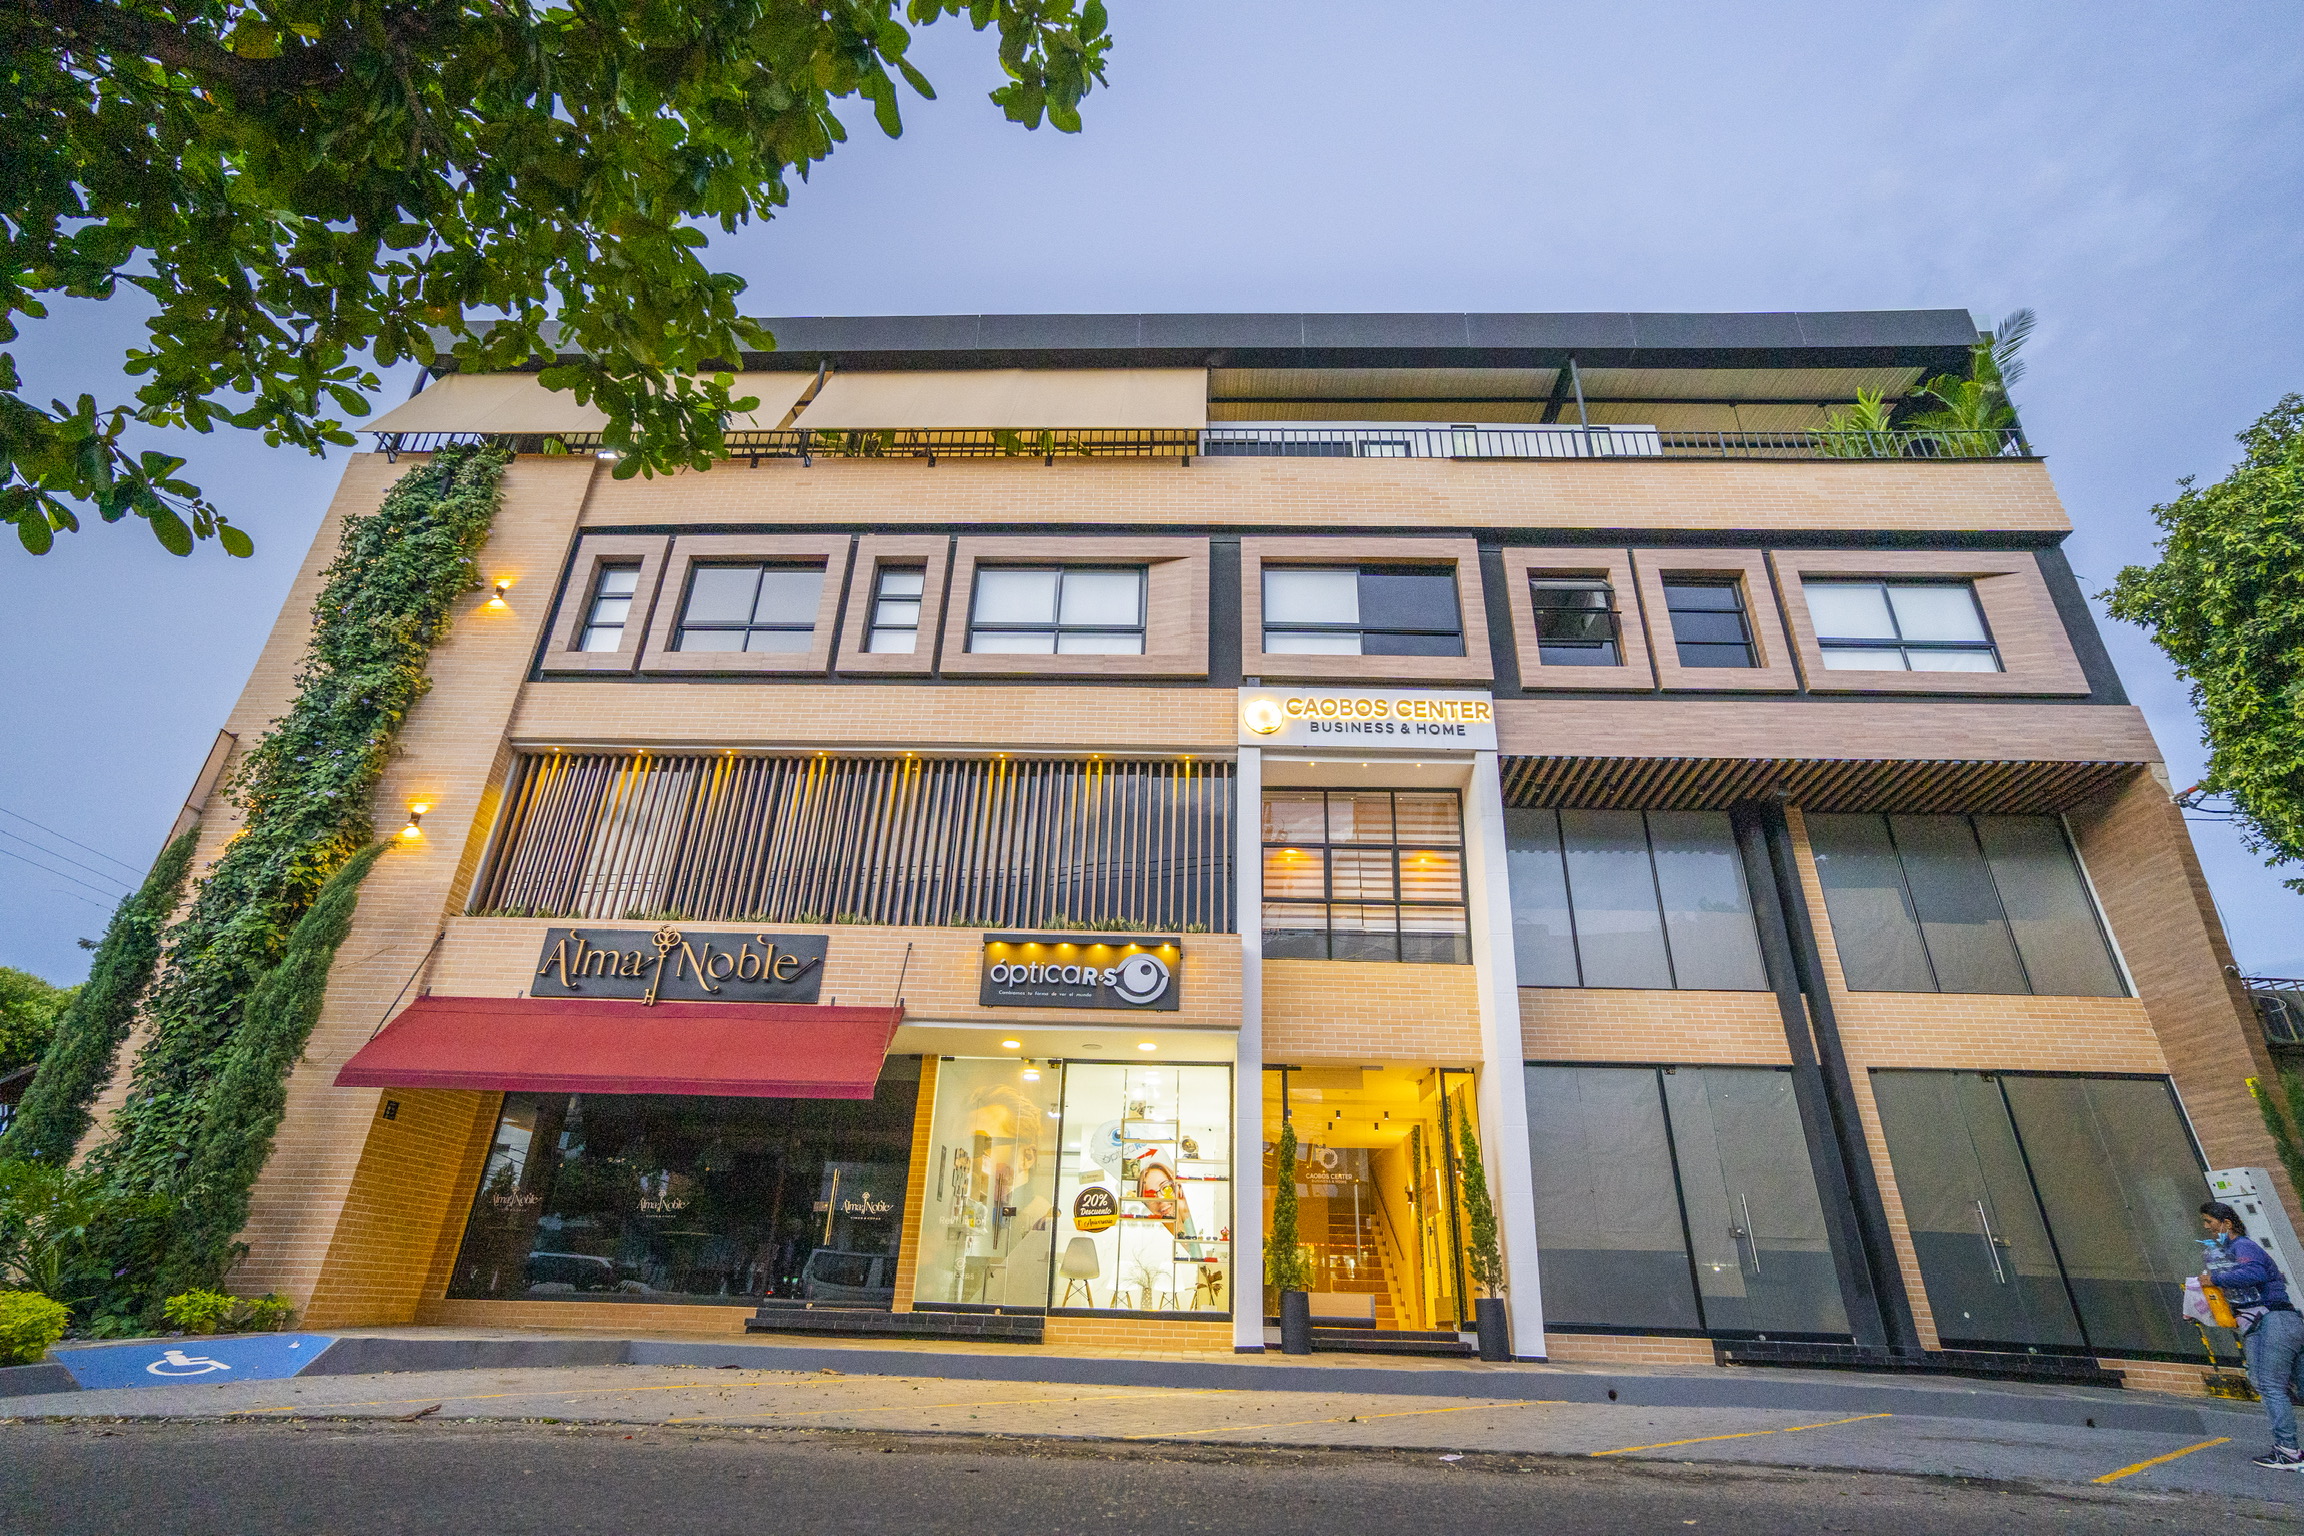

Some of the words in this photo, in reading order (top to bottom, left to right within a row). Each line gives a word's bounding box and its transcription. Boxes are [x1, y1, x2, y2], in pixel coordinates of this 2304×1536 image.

[1286, 698, 1389, 717] CAOBOS
[1395, 700, 1490, 720] CENTER
[1310, 721, 1395, 735] BUSINESS
[1400, 723, 1411, 734] &
[1416, 723, 1466, 736] HOME
[537, 928, 656, 990] Alma
[676, 933, 819, 994] Noble
[1082, 1194, 1108, 1207] 20%
[1080, 1207, 1112, 1216] Descuento
